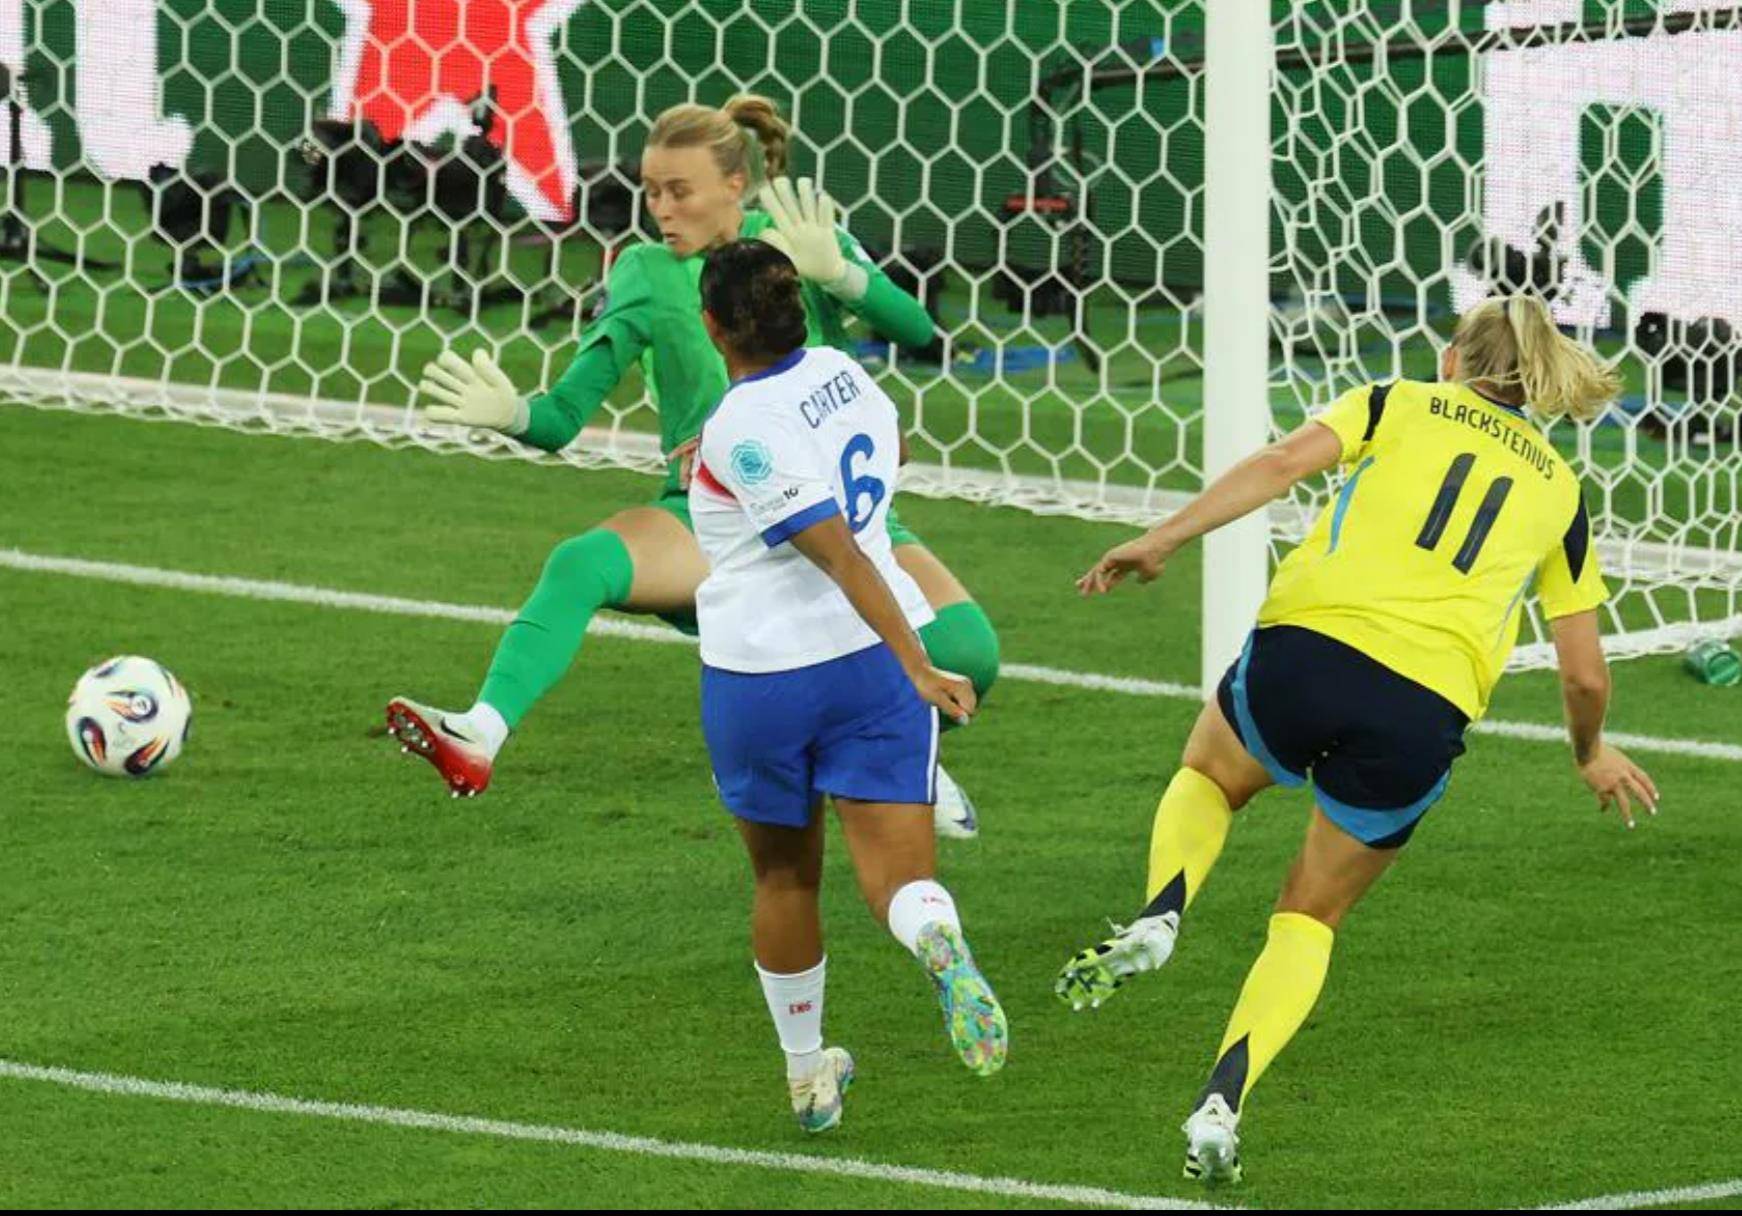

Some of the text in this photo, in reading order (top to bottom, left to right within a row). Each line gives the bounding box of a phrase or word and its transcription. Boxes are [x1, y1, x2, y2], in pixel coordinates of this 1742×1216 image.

[840, 433, 885, 533] 6
[1430, 397, 1555, 480] BLACKSTENIUS
[1414, 453, 1514, 575] 11
